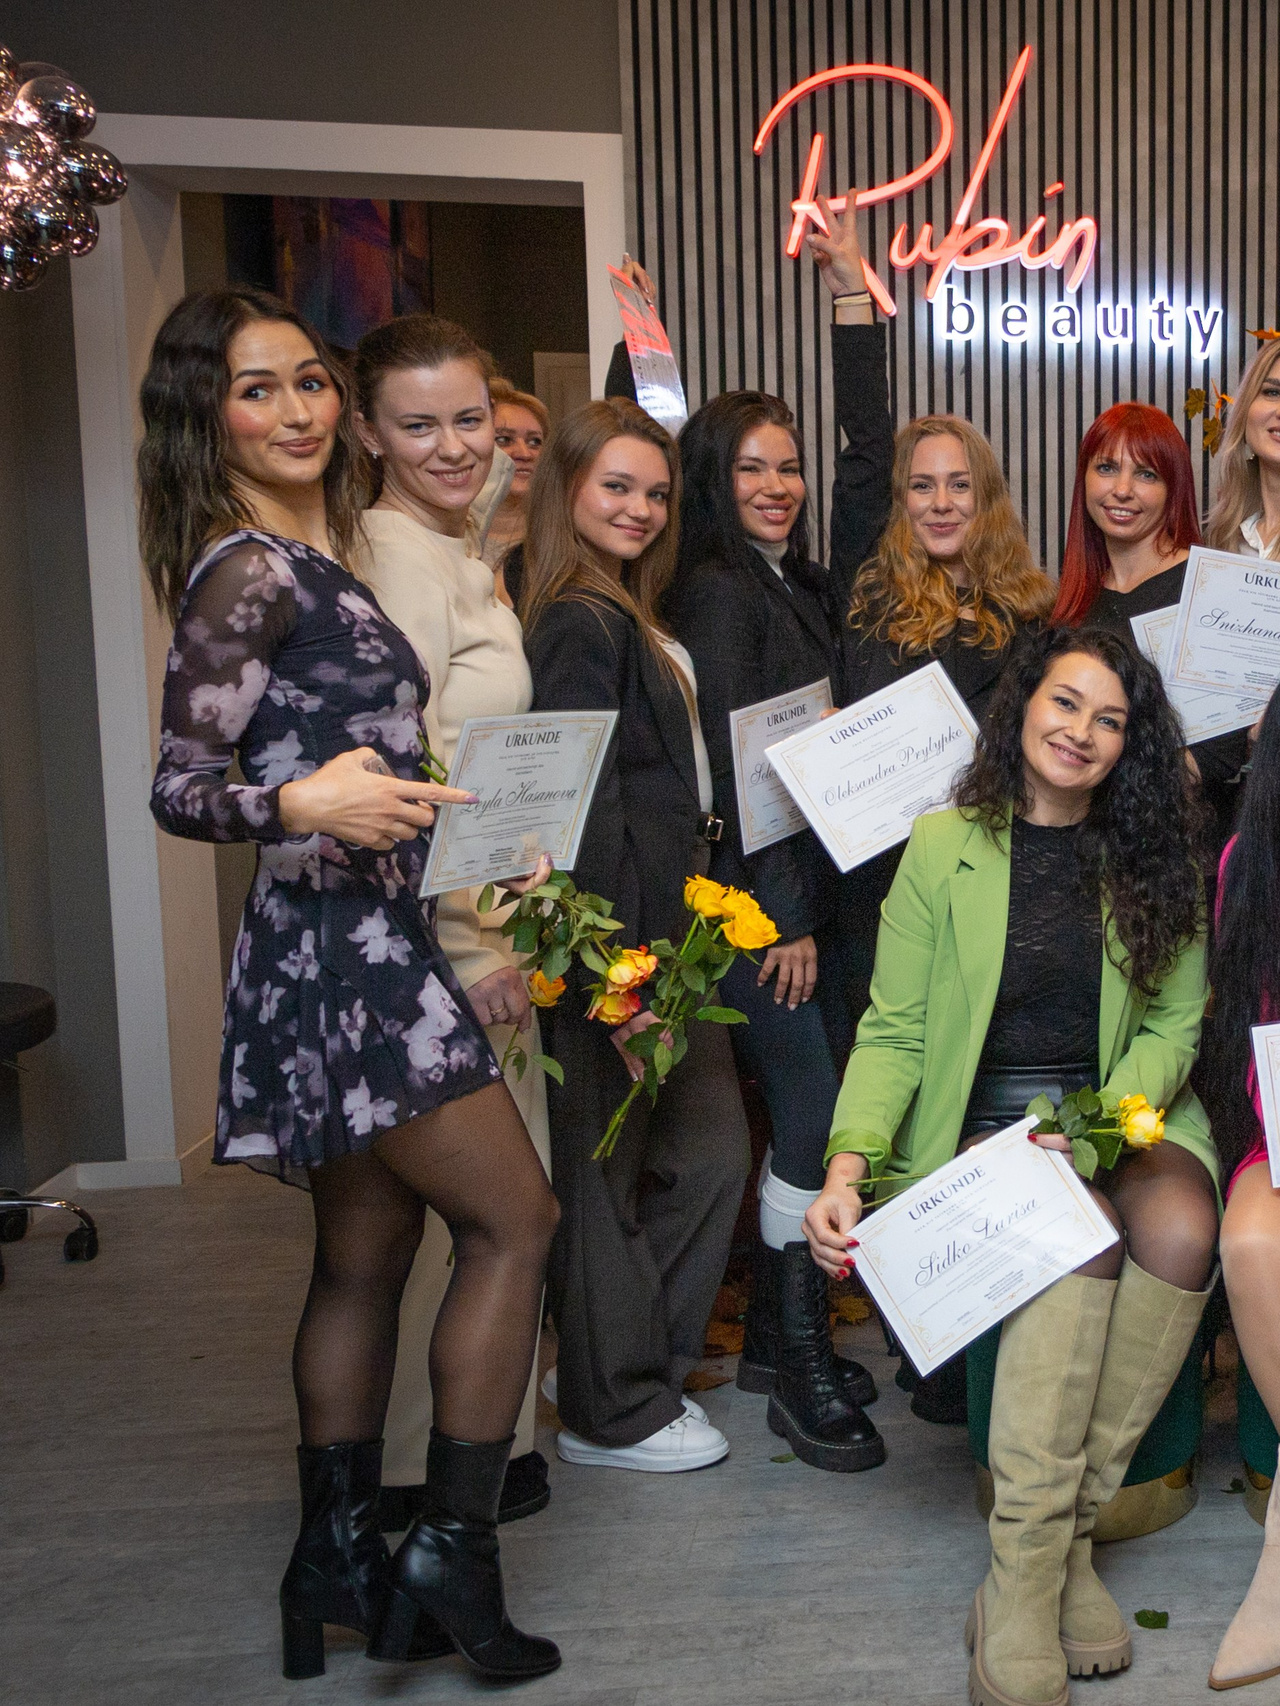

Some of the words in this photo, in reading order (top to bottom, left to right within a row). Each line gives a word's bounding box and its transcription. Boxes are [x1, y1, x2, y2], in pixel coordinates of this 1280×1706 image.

[753, 44, 1097, 317] Rubin
[943, 286, 1222, 358] beauty
[766, 703, 808, 728] URKUNDE
[829, 704, 897, 745] URKUNDE
[505, 730, 563, 748] URKUNDE
[505, 780, 578, 806] Hasanova
[821, 763, 898, 807] Oleksandra
[908, 1165, 986, 1222] URKUNDE
[914, 1240, 972, 1287] Sidko
[972, 1197, 1040, 1244] Larisa
